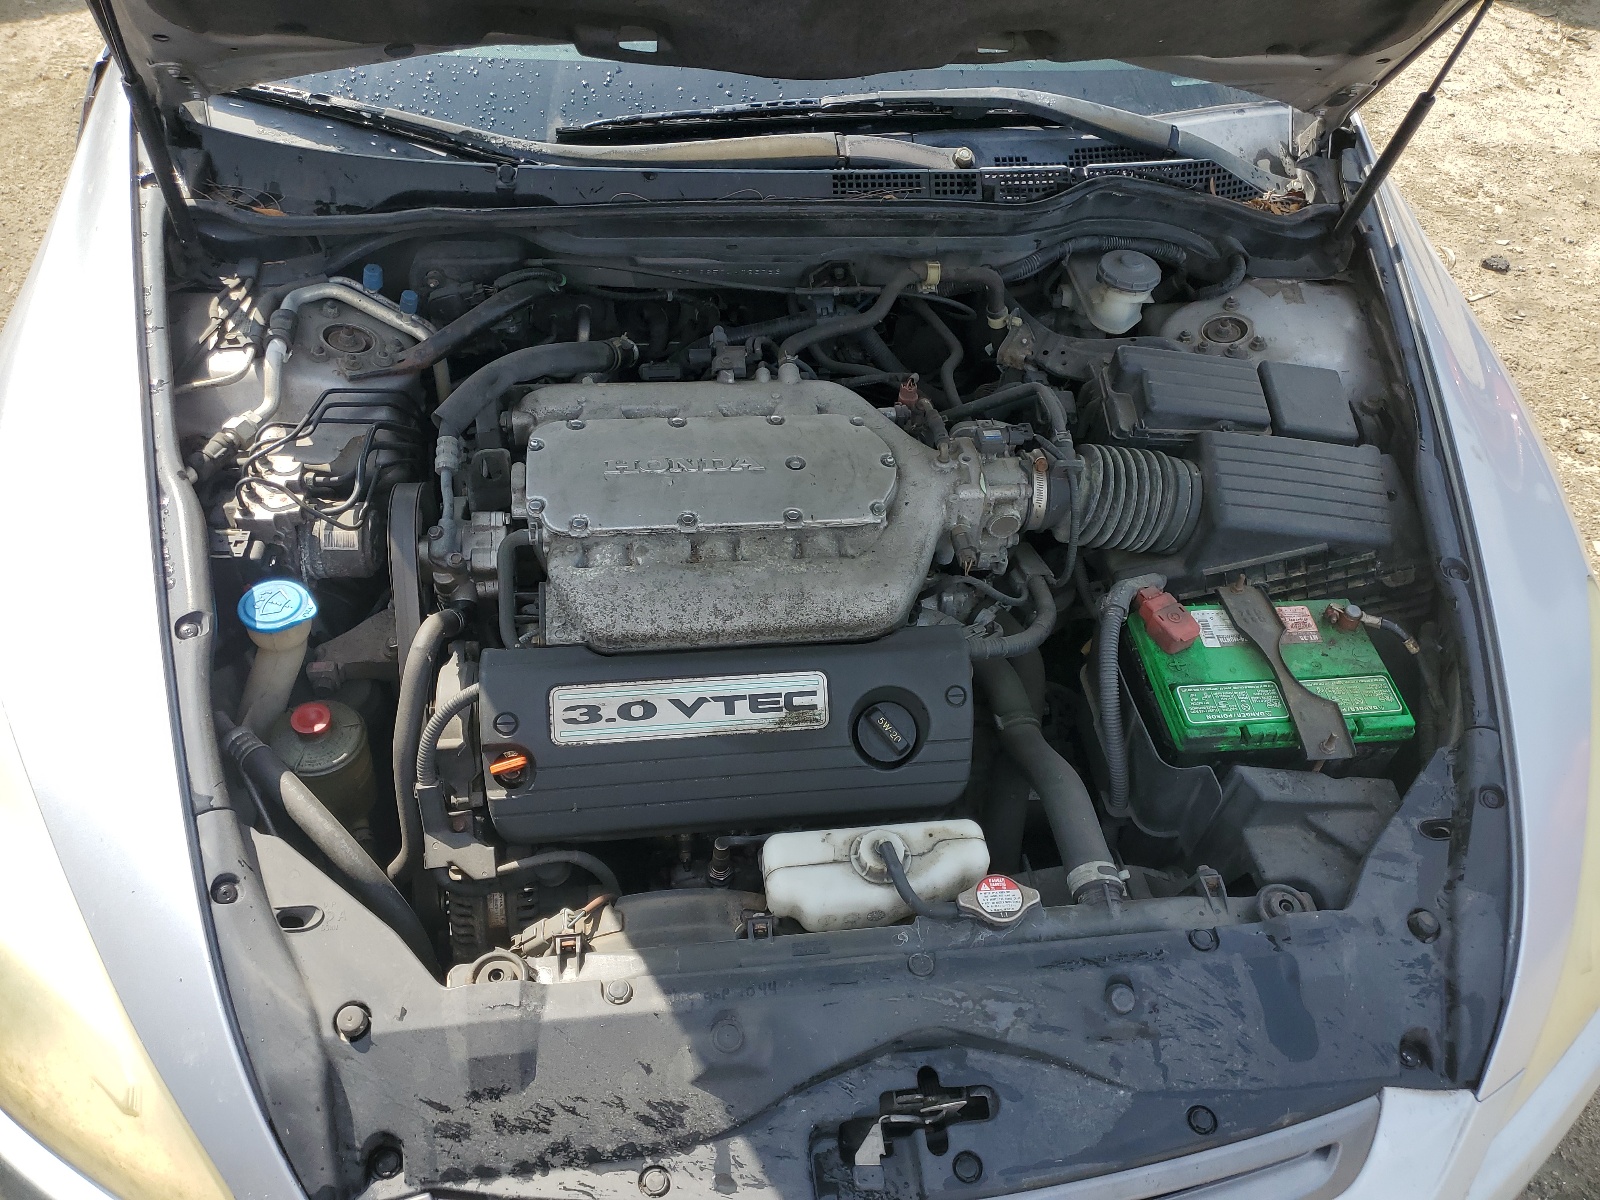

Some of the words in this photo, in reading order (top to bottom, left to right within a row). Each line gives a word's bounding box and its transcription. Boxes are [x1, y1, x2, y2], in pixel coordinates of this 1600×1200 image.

[603, 456, 765, 476] HONDA
[562, 700, 658, 725] 3.0
[667, 690, 818, 719] VTEC
[877, 716, 902, 743] 5W-20
